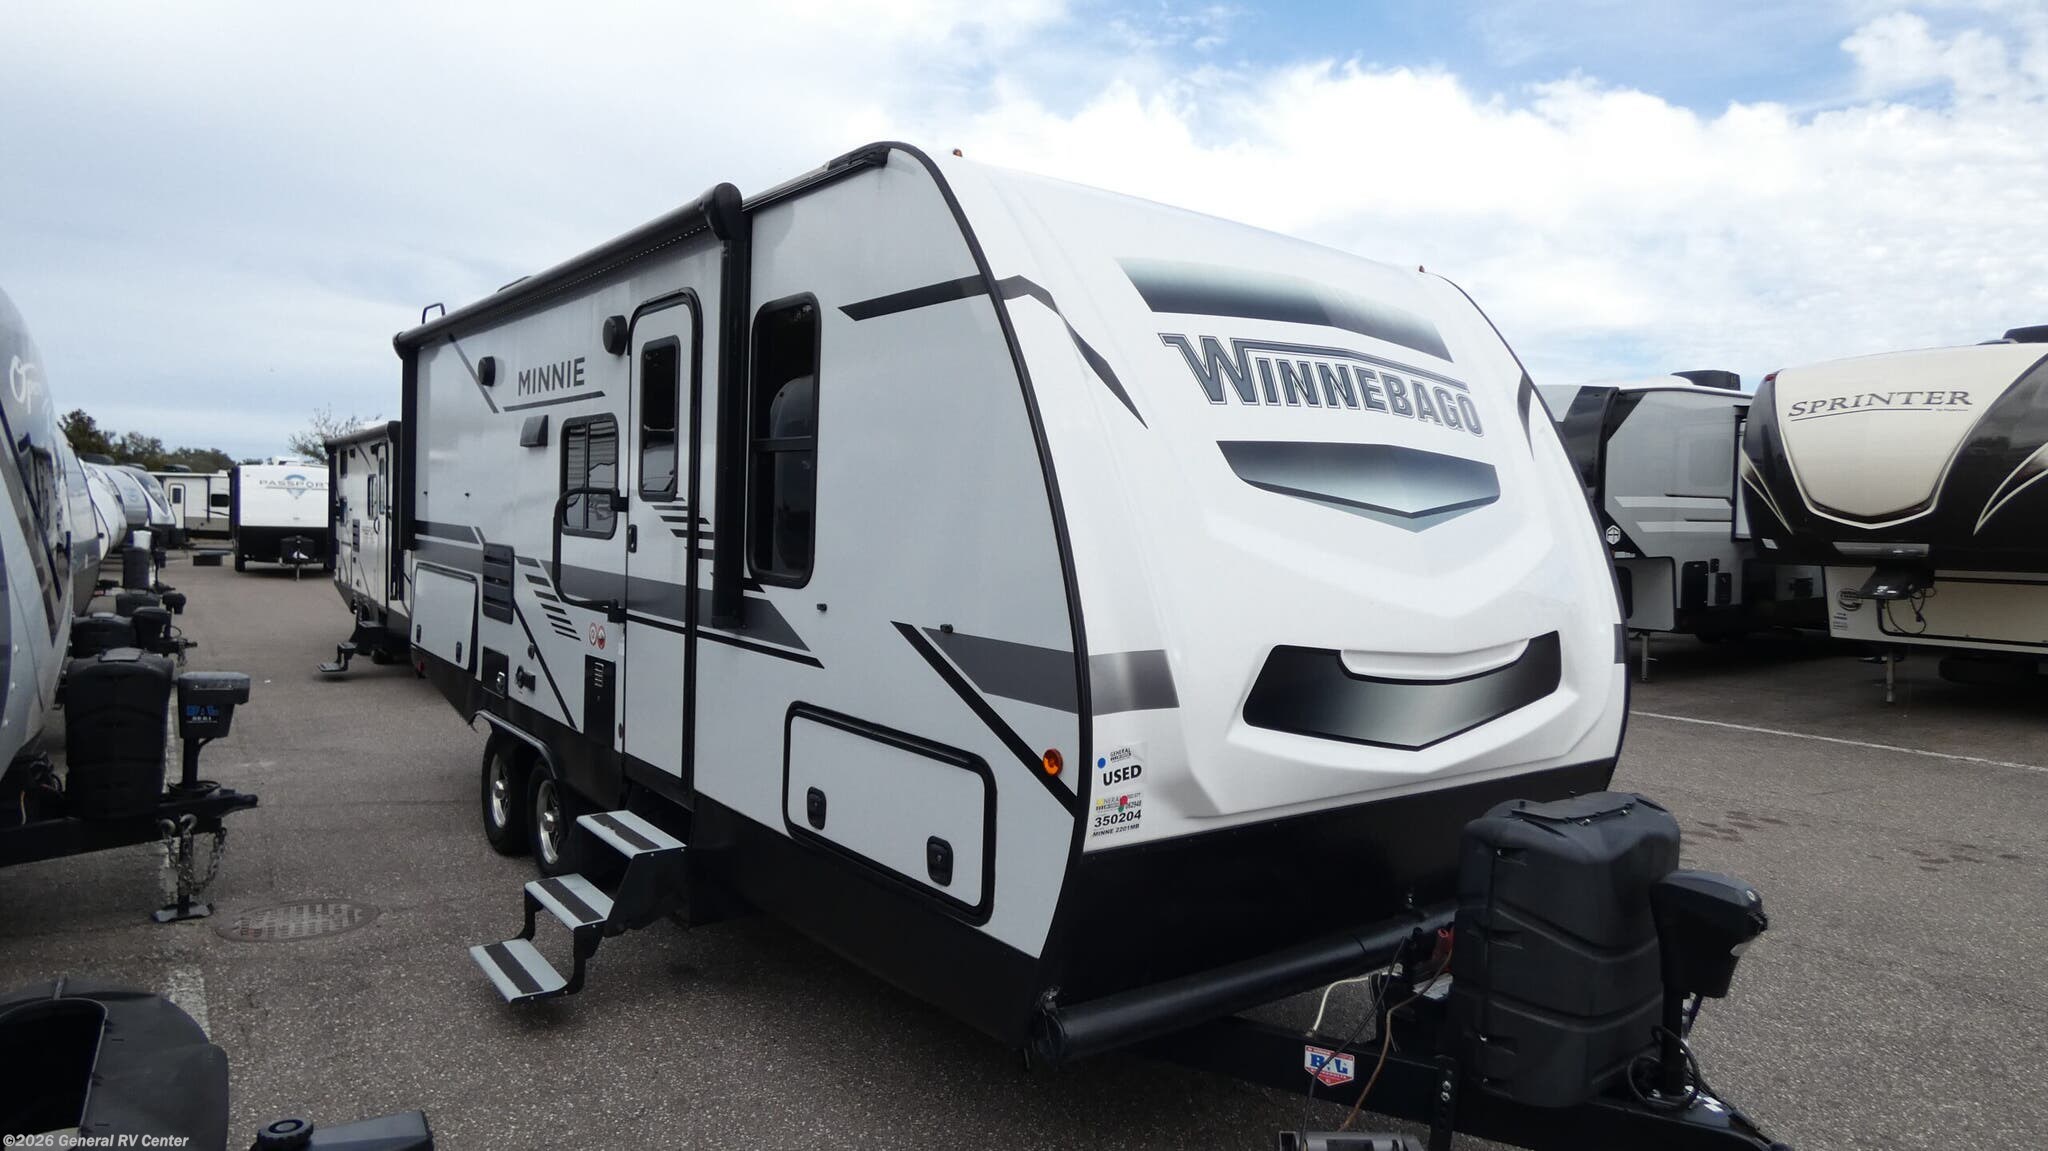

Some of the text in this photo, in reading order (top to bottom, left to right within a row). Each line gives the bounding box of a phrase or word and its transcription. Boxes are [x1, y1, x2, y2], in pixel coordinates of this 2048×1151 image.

[518, 357, 585, 397] MINNIE
[1157, 333, 1484, 437] WINNEBAGO
[1788, 390, 1972, 418] SPRINTER
[1103, 764, 1142, 786] USED
[1094, 809, 1141, 828] 350204
